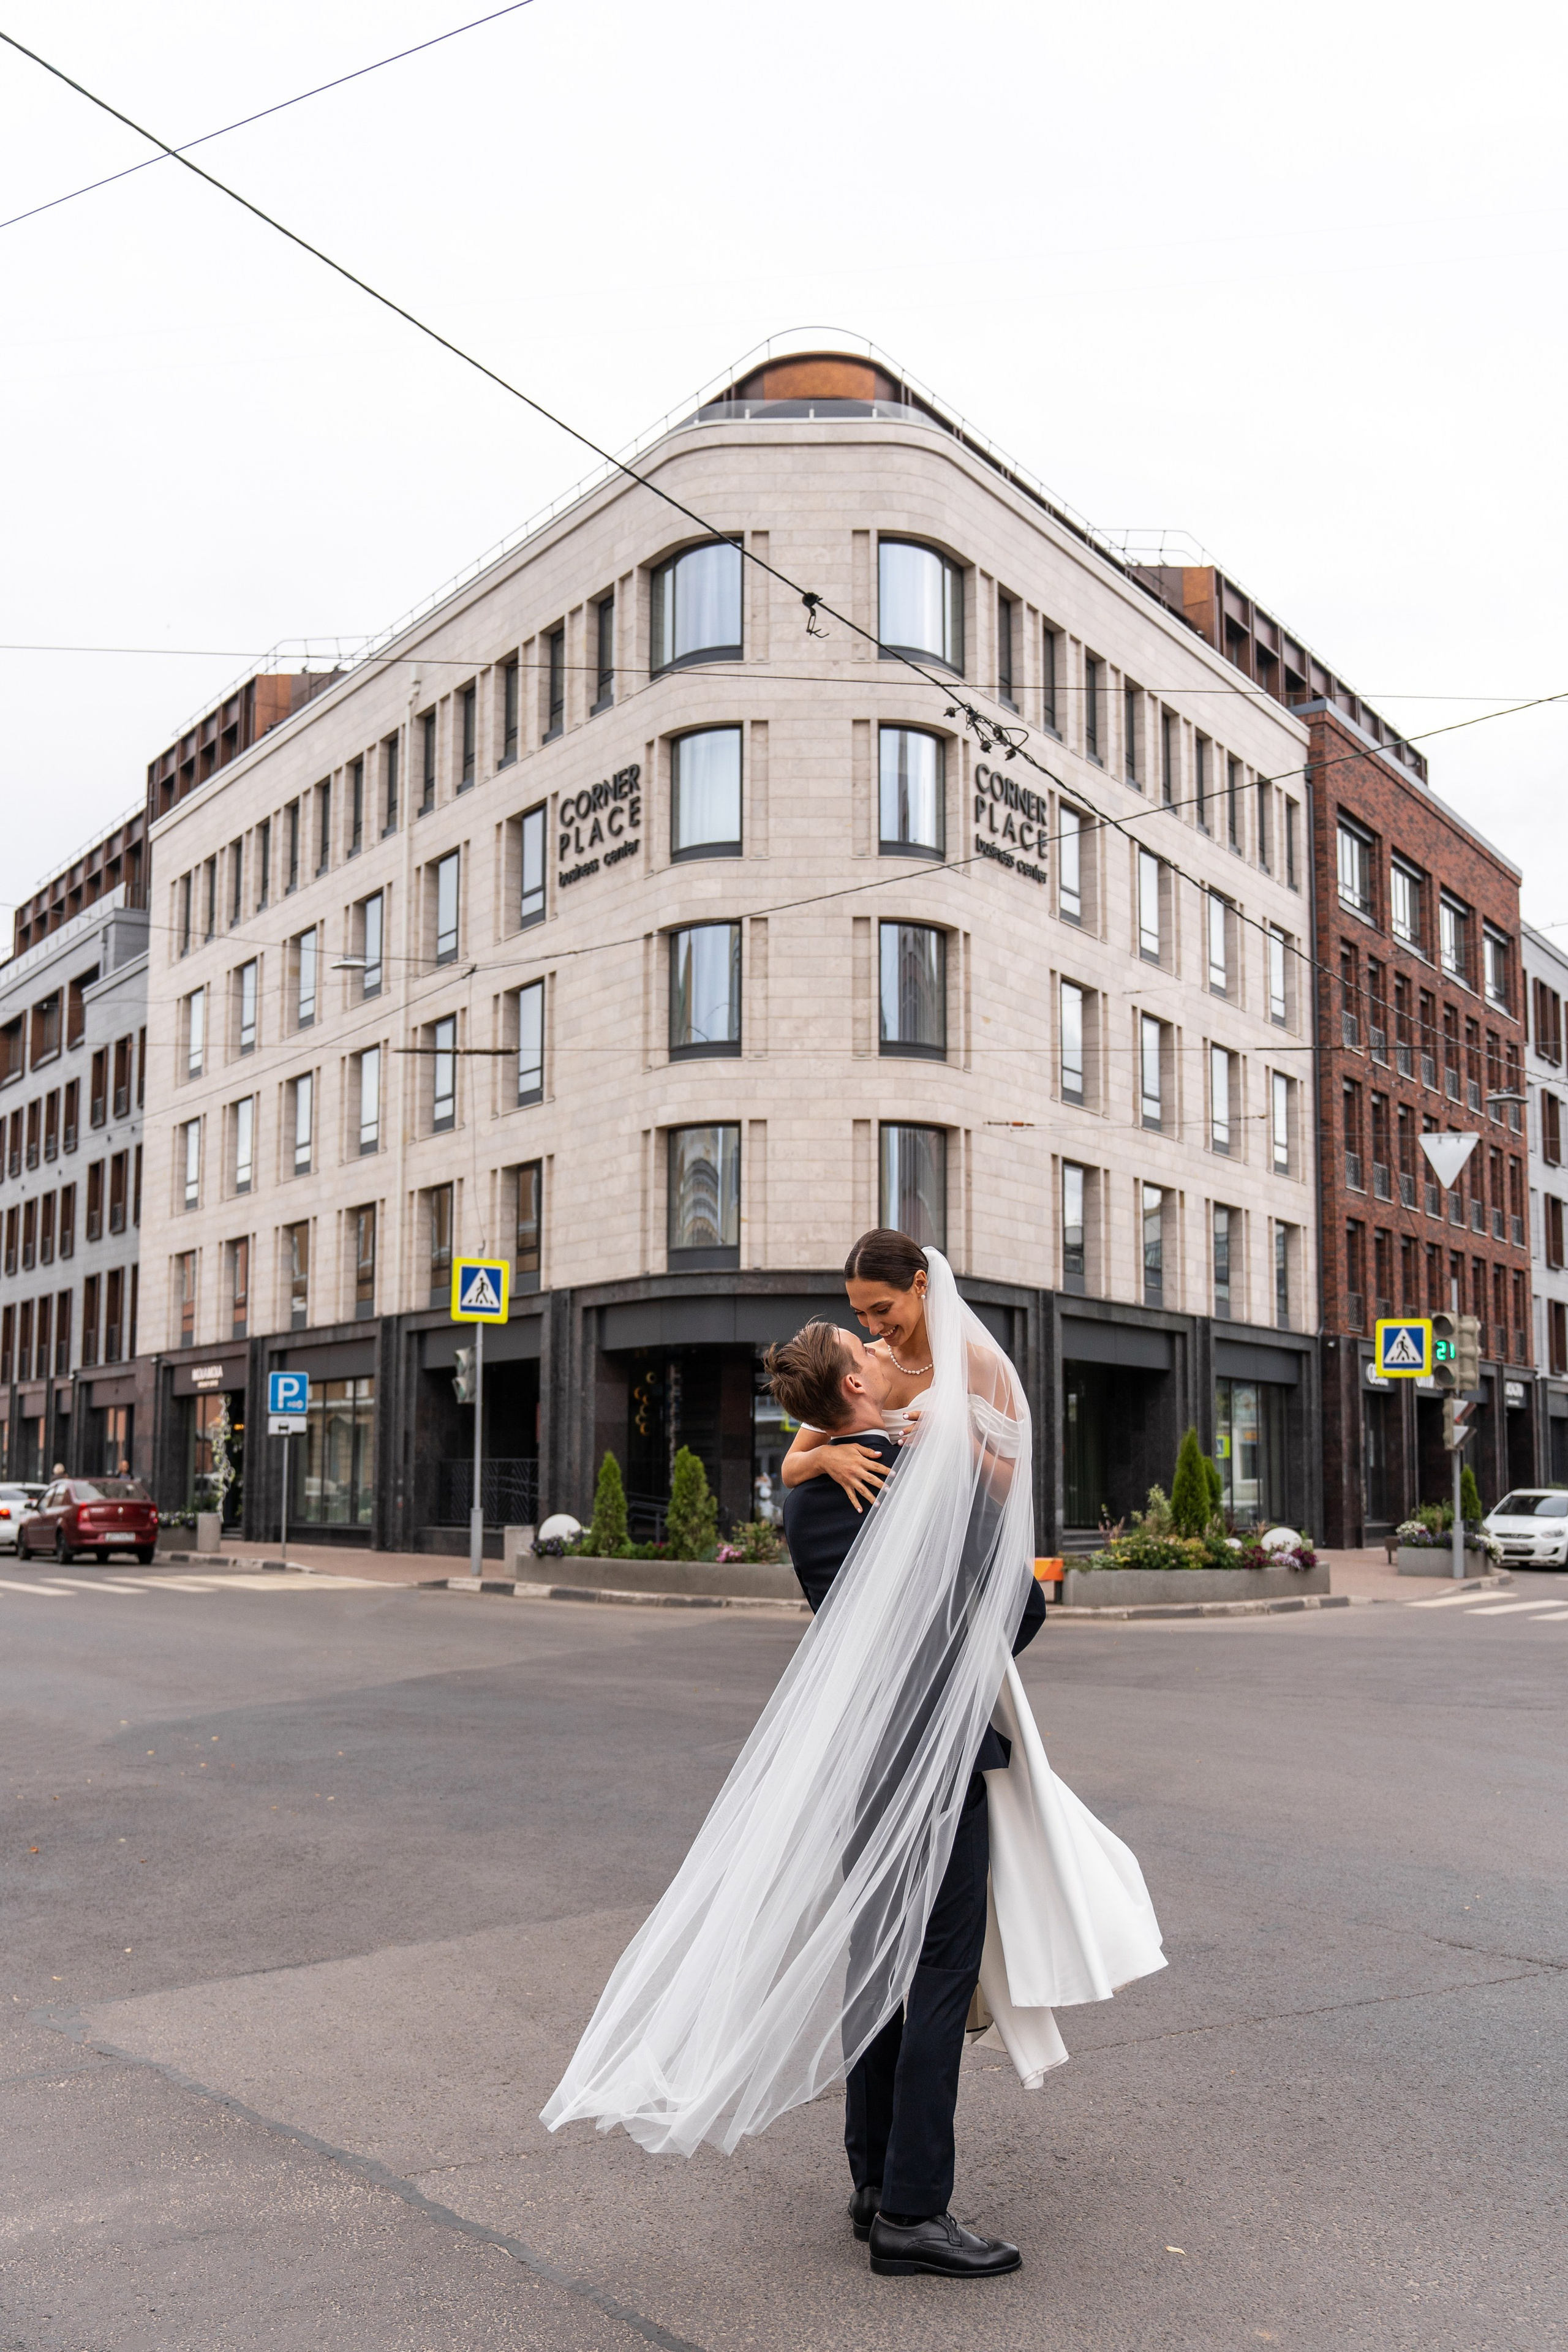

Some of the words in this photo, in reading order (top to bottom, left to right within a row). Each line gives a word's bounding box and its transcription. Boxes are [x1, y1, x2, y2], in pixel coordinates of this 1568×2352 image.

[560, 764, 641, 827] CORNER
[976, 764, 1047, 826] CORNER
[559, 796, 641, 861] PLACE
[975, 795, 1047, 859] PLACE
[559, 858, 599, 887] business
[603, 839, 640, 866] center
[976, 834, 1014, 867] business
[1017, 860, 1047, 884] center
[1436, 1341, 1455, 1360] 21
[277, 1377, 300, 1409] P
